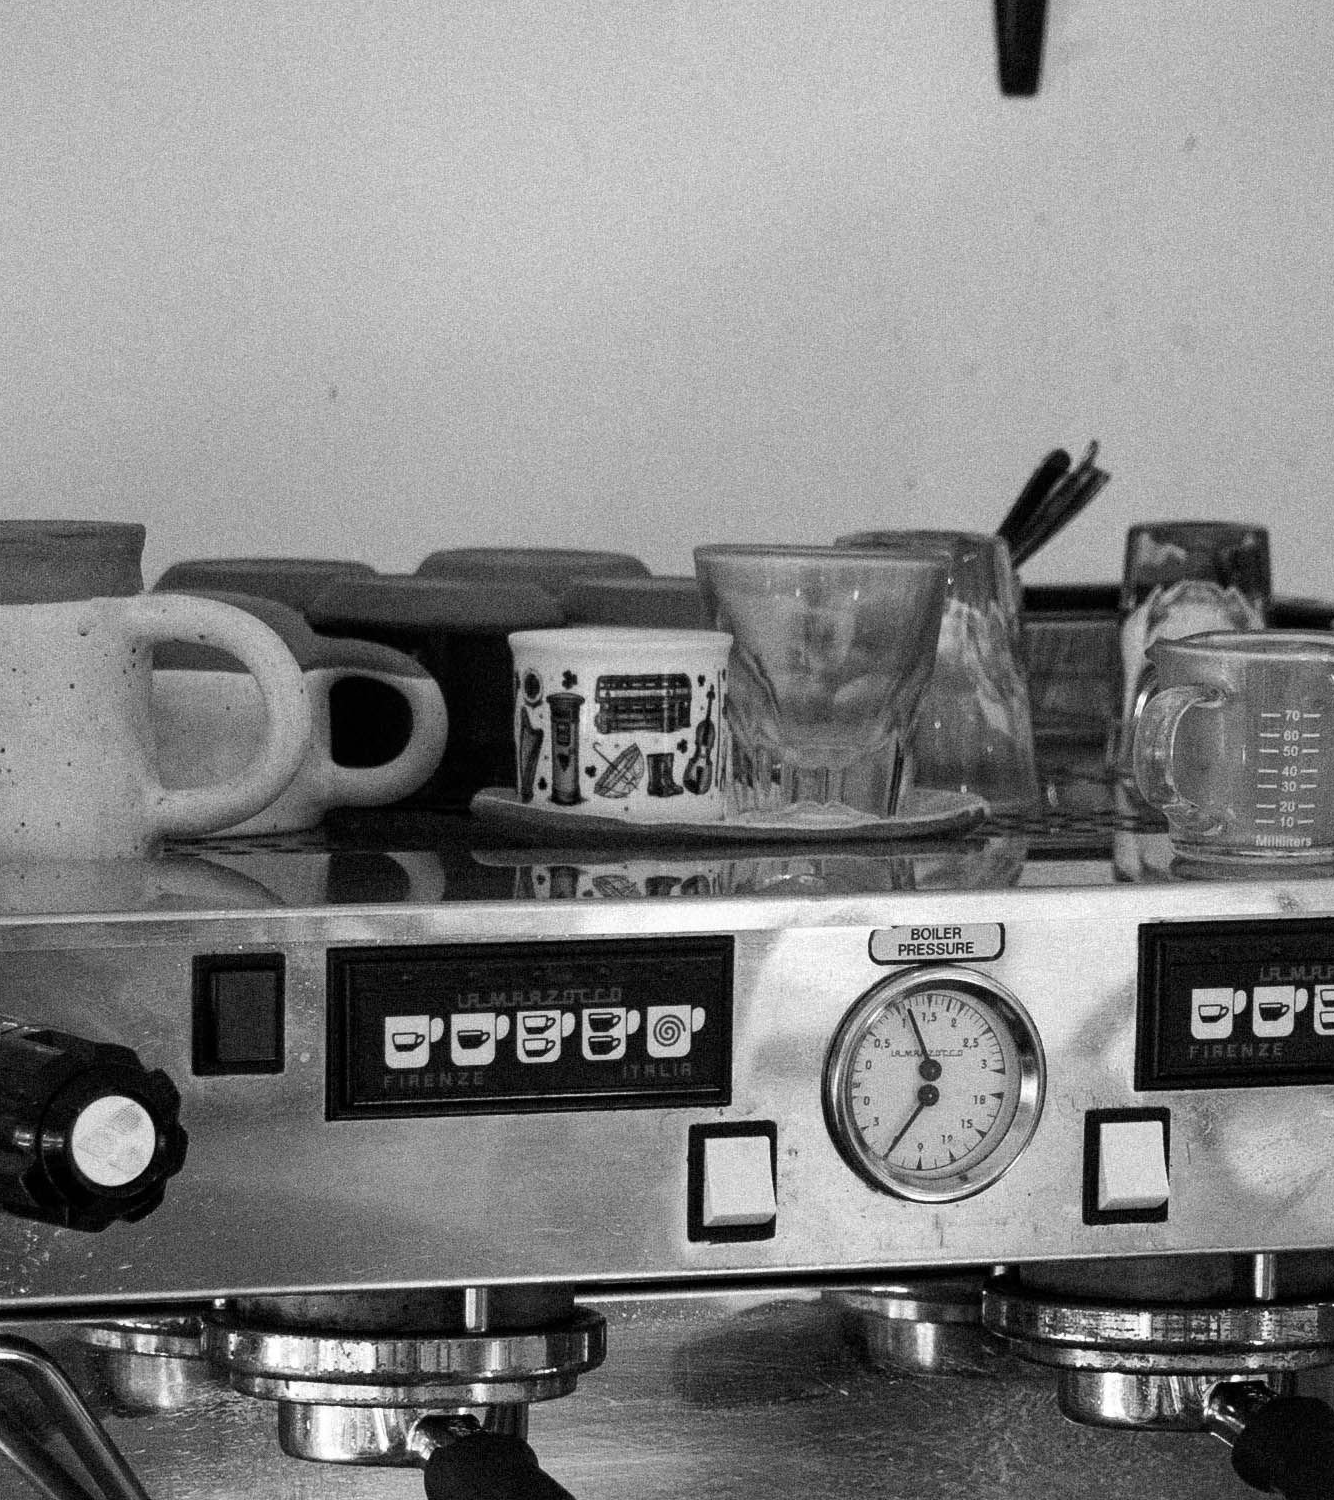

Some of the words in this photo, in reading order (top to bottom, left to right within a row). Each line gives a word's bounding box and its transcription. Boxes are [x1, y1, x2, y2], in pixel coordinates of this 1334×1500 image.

[1285, 709, 1301, 721] 70
[1283, 730, 1300, 741] 60
[1283, 745, 1299, 757] 50
[1281, 765, 1298, 777] 40
[1281, 781, 1297, 792] 30
[1279, 801, 1296, 812] 20
[1279, 816, 1295, 828] 10
[910, 926, 962, 941] BOILER
[898, 941, 975, 956] PRESSURE
[922, 1012, 938, 1024] 1,5
[951, 1018, 957, 1028] 2
[874, 1038, 891, 1050] 0,5
[963, 1038, 979, 1050] 2,5
[1188, 1042, 1284, 1059] FIRENZE
[865, 1060, 872, 1070] 0
[981, 1059, 988, 1069] 3
[621, 1062, 693, 1080] ITALIA
[383, 1071, 485, 1090] FIRENZE
[863, 1096, 870, 1106] 0
[973, 1094, 986, 1105] 18
[873, 1116, 880, 1127] 3
[961, 1118, 973, 1129] 15
